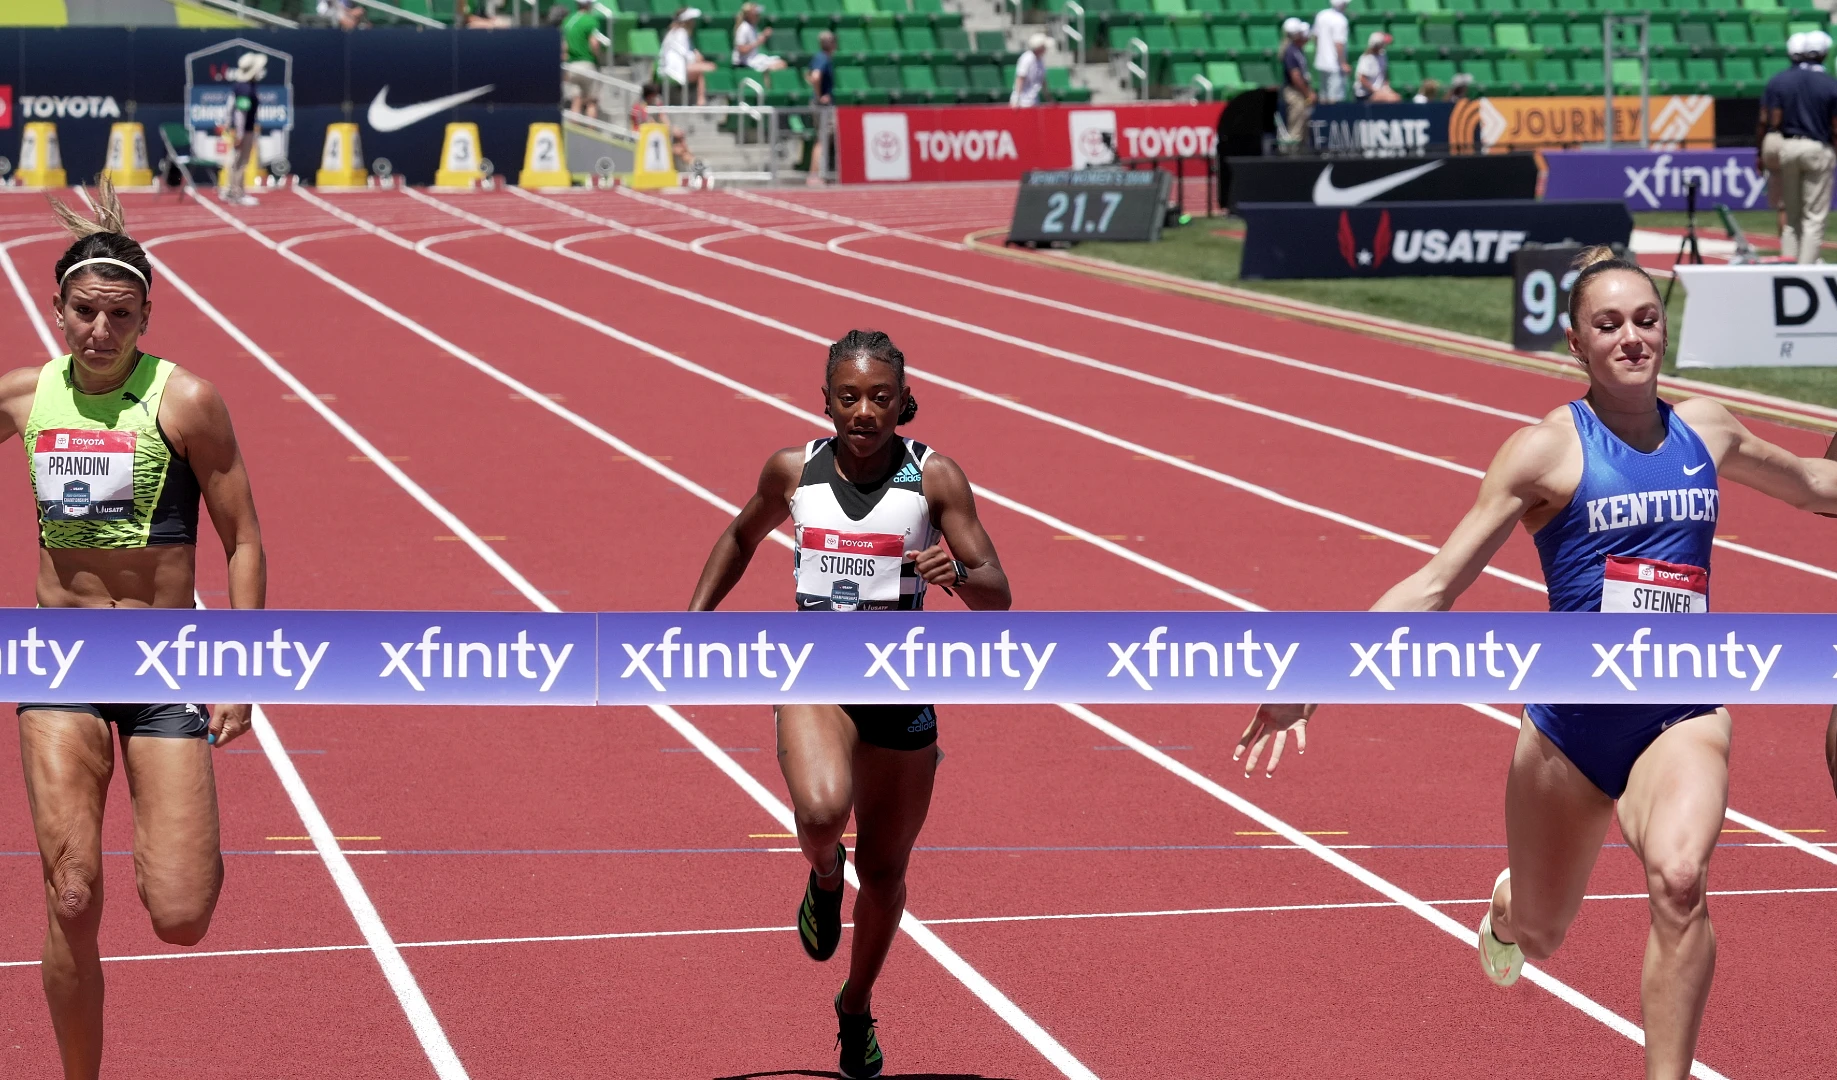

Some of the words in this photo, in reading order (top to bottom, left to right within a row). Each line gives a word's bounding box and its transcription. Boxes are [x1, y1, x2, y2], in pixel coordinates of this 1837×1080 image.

[19, 95, 121, 118] TOYOTA
[454, 138, 470, 161] 3
[538, 138, 554, 161] 2
[914, 130, 1018, 161] TOYOTA
[1624, 154, 1770, 208] xfinity
[1041, 190, 1123, 233] 21.7
[1392, 229, 1526, 263] USATF
[72, 438, 105, 446] TOYOTA
[49, 456, 110, 476] PRANDINI
[893, 473, 921, 482] adidas
[841, 539, 874, 549] TOYOTA
[820, 555, 876, 577] STURGIS
[1632, 587, 1691, 613] STEINER
[135, 624, 330, 690] xfinity
[379, 626, 574, 692] xfinity
[620, 626, 815, 692] xfinity
[864, 626, 1057, 691] xfinity
[1106, 626, 1300, 691] xfinity
[1349, 626, 1542, 691] xfinity
[1591, 627, 1783, 691] xfinity
[907, 719, 935, 732] adidas
